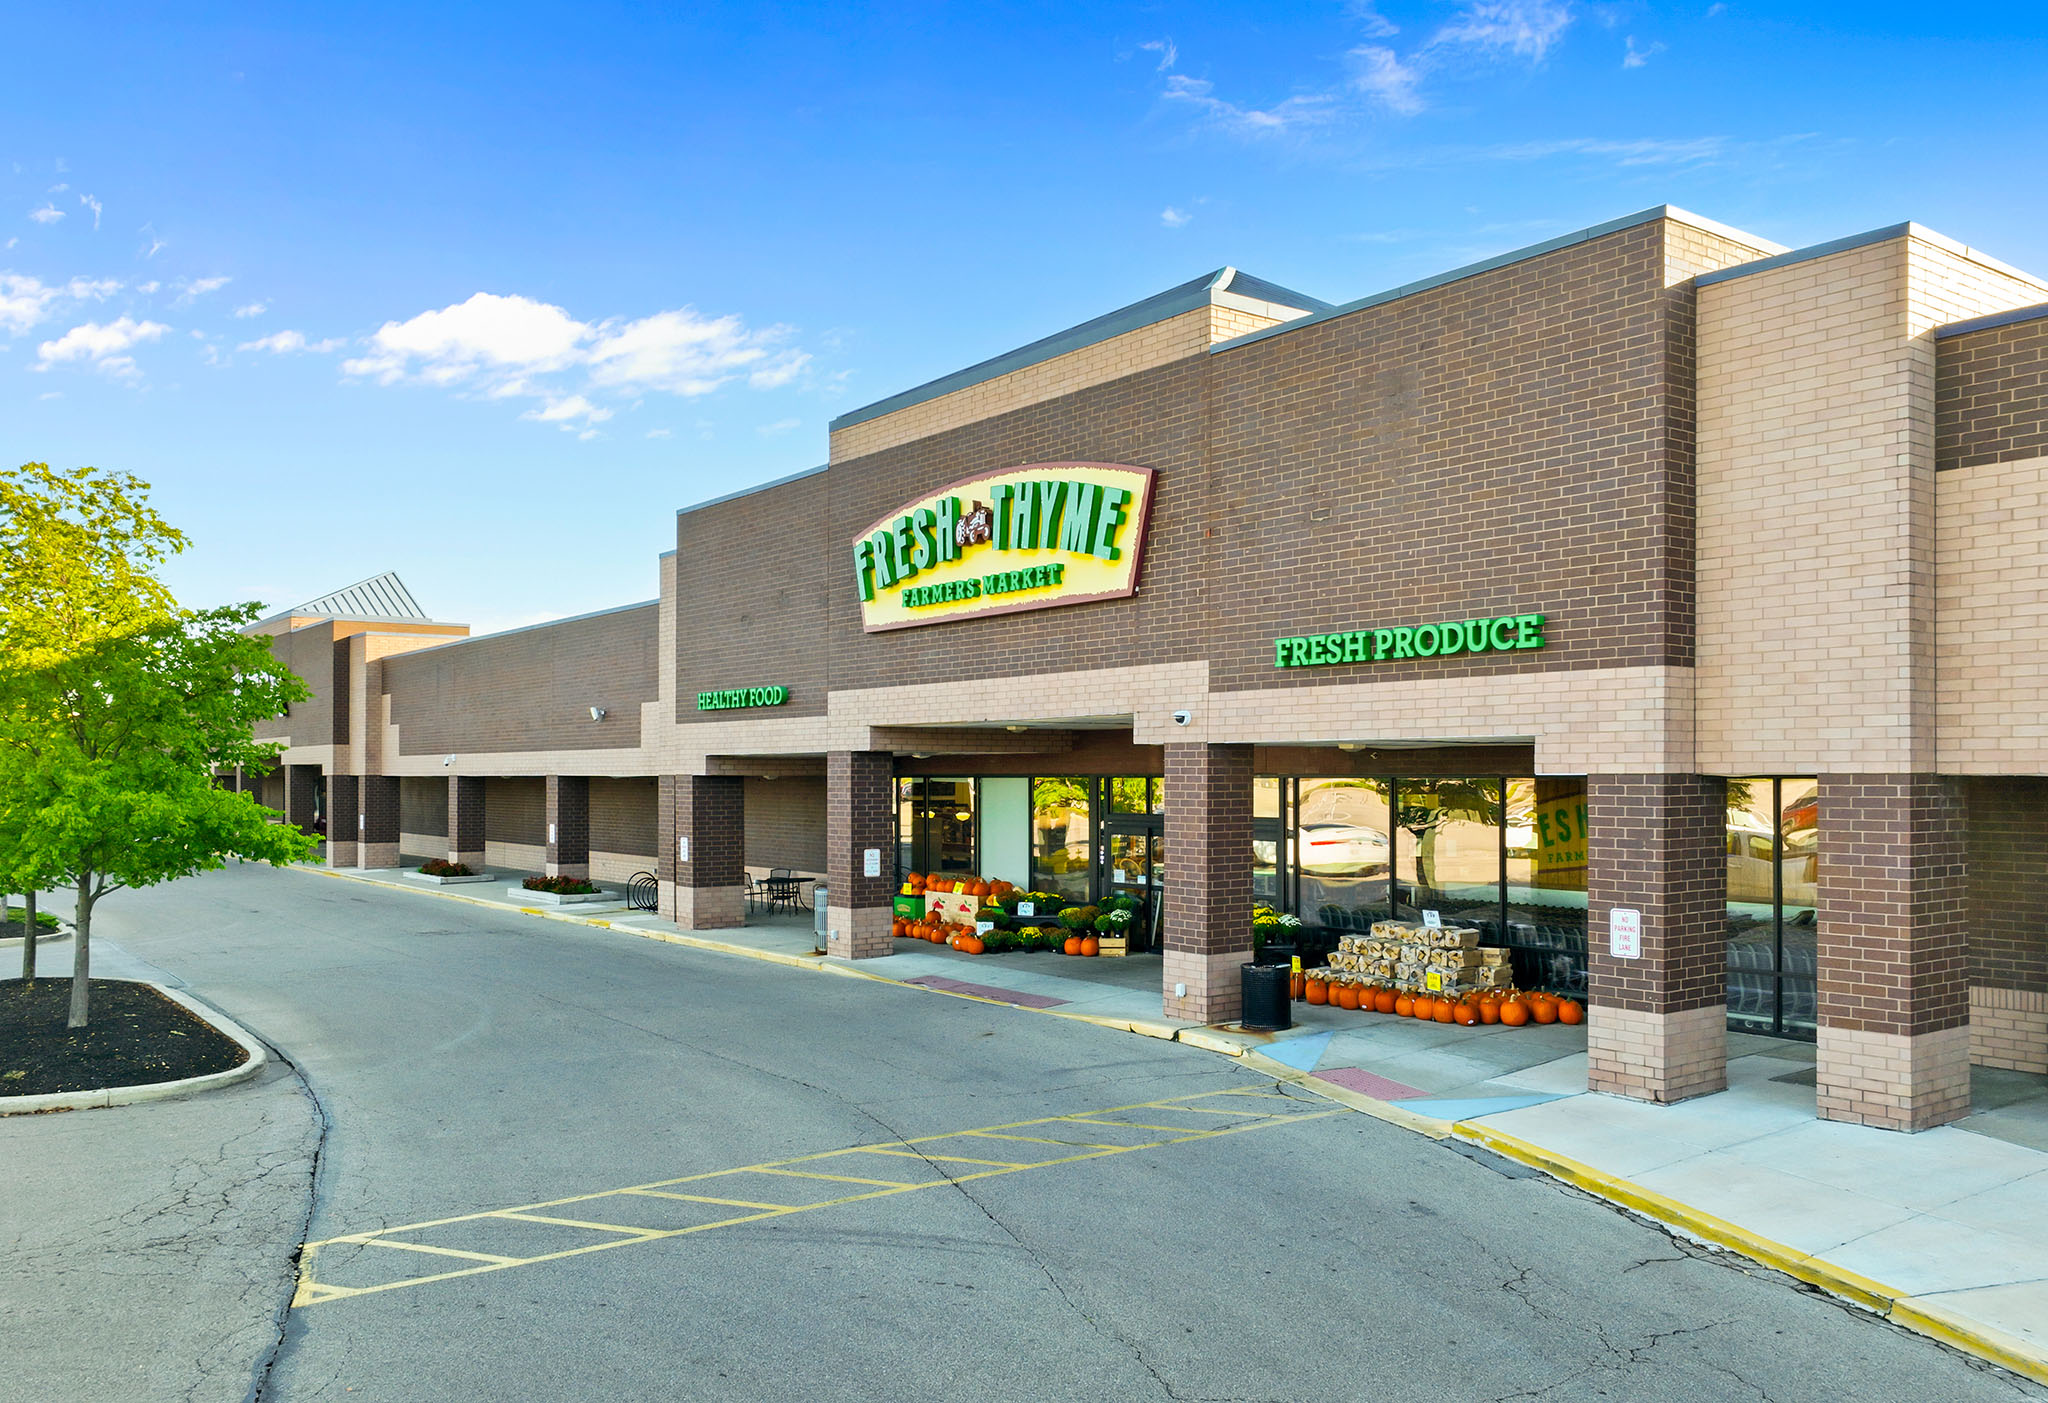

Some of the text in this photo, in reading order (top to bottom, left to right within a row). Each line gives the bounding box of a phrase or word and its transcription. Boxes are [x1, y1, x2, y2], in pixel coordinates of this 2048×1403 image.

[853, 480, 1131, 602] FRESH THYME
[901, 563, 1065, 608] FARMERS MARKET
[1274, 614, 1545, 668] FRESH PRODUCE
[697, 685, 789, 711] HEALTHY FOOD
[1614, 924, 1636, 933] PARKING
